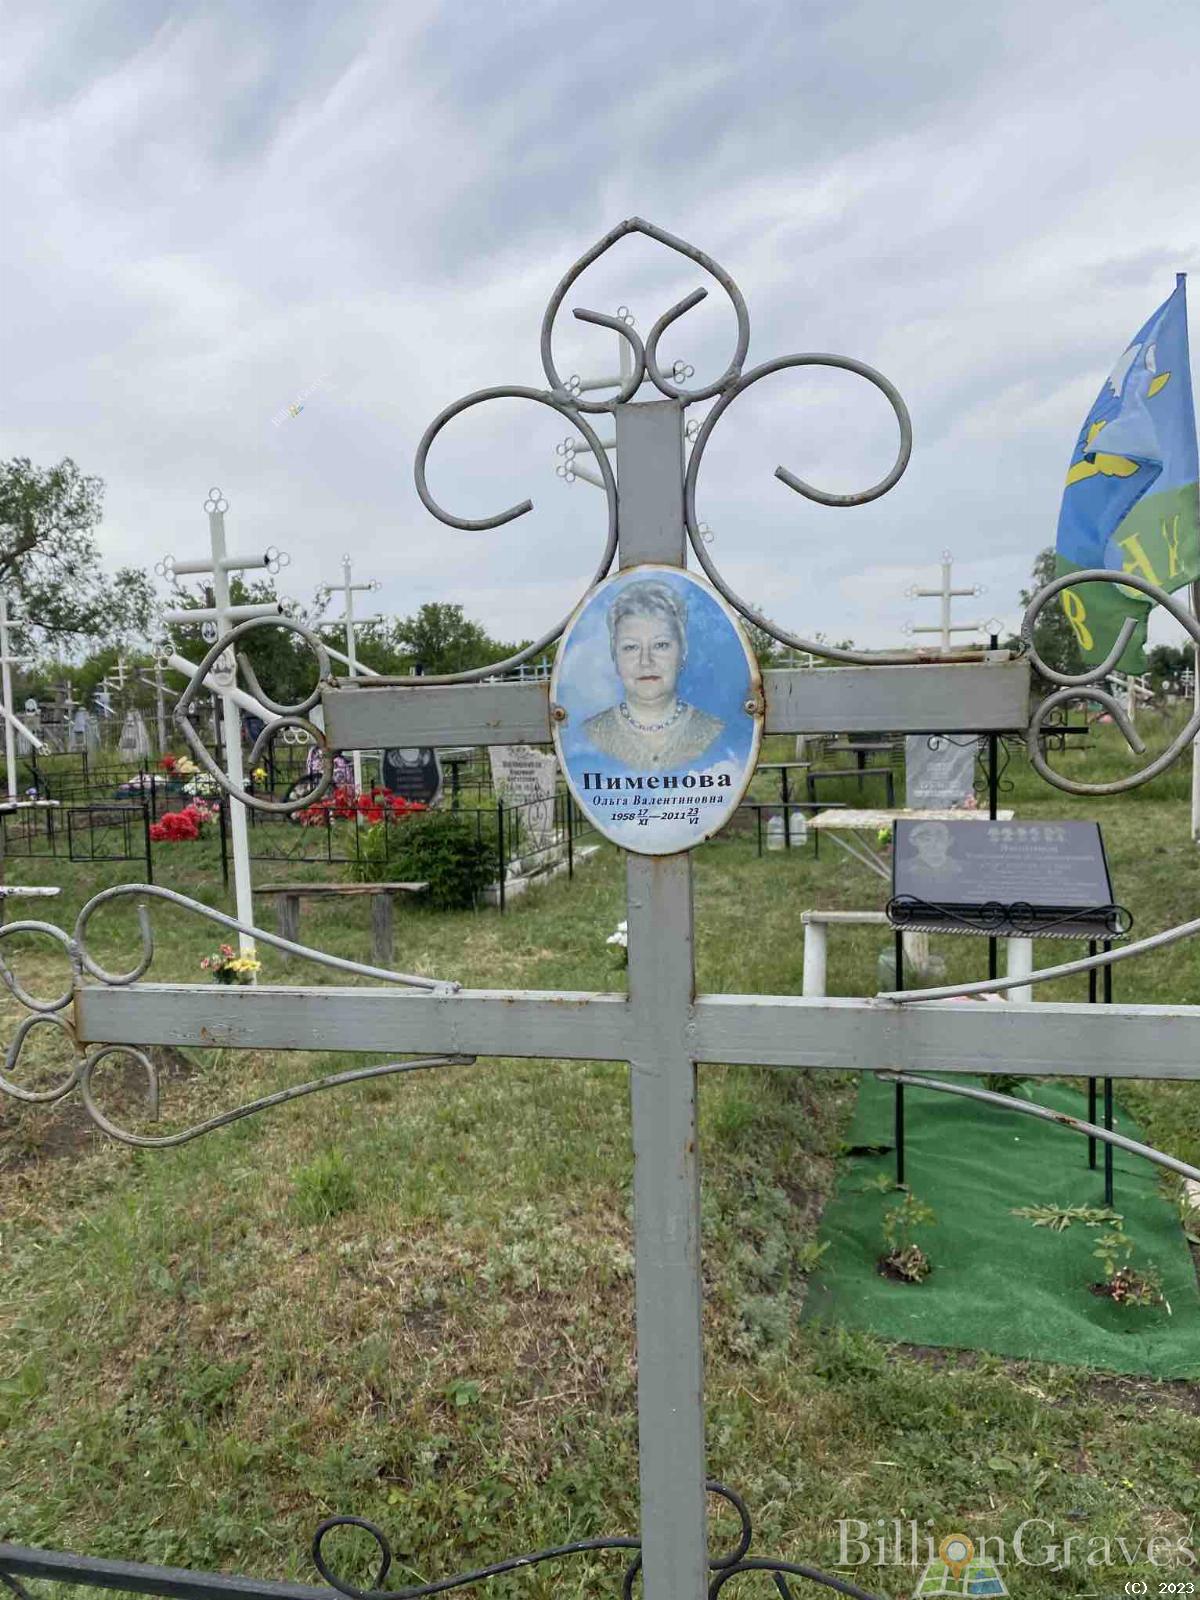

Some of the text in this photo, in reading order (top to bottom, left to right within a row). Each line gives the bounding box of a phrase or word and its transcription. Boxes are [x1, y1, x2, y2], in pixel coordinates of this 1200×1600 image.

[583, 772, 732, 790] Пименова
[592, 794, 724, 806] Ольга Валентиновна
[610, 812, 636, 821] 1958
